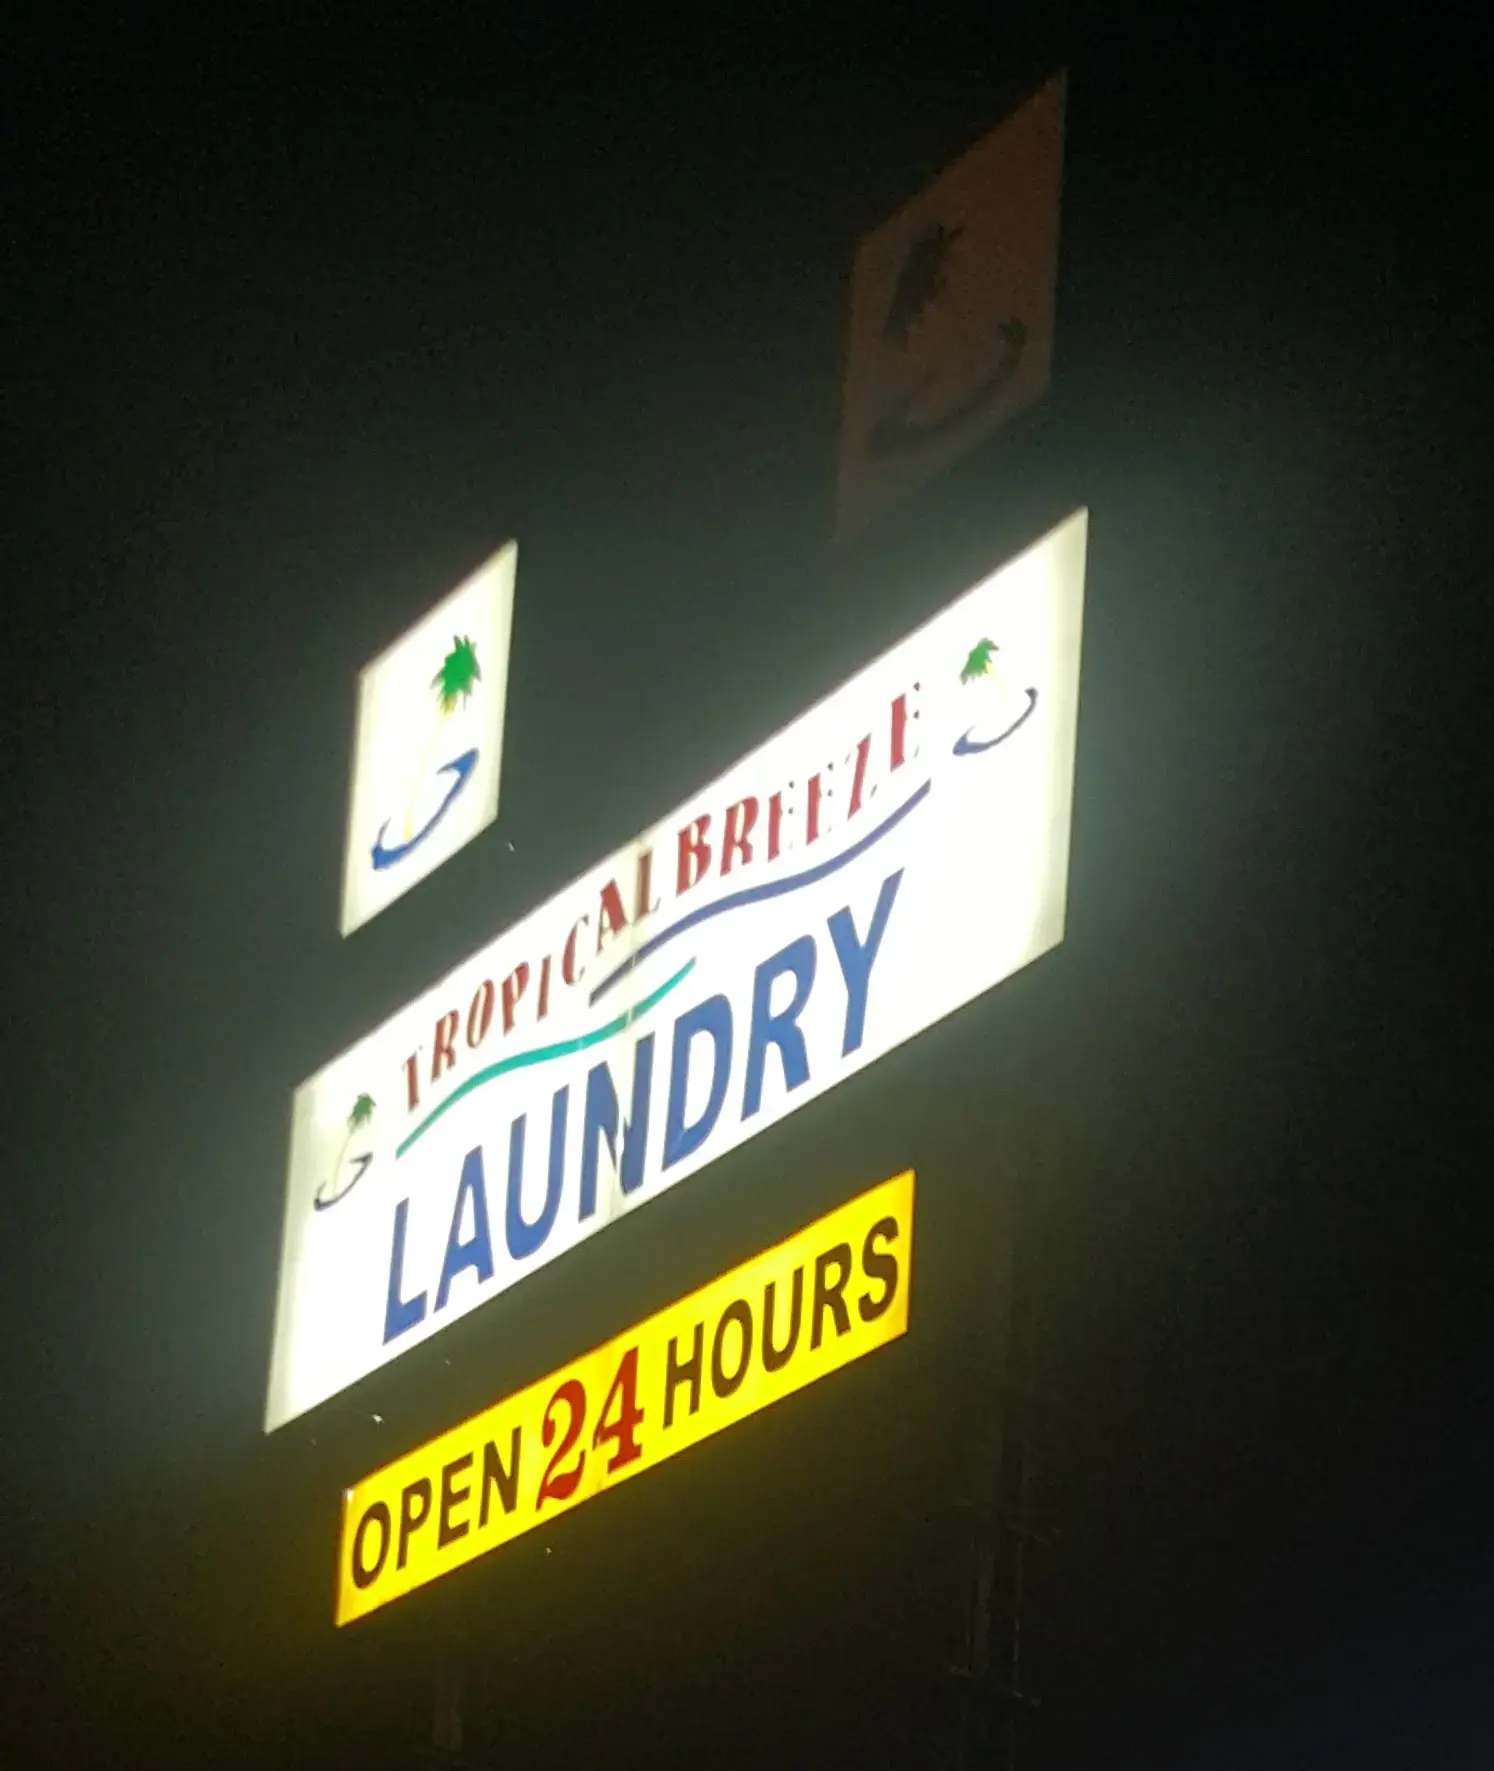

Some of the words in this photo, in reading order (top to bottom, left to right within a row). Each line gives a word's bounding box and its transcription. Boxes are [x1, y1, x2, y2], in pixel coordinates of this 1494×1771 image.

[382, 867, 905, 1346] LAUNDRY
[401, 851, 661, 1113] TROPICAL
[674, 681, 920, 898] BREEZE
[351, 1426, 521, 1590] OPEN
[535, 1346, 644, 1512] 24
[662, 1215, 899, 1432] HOURS
